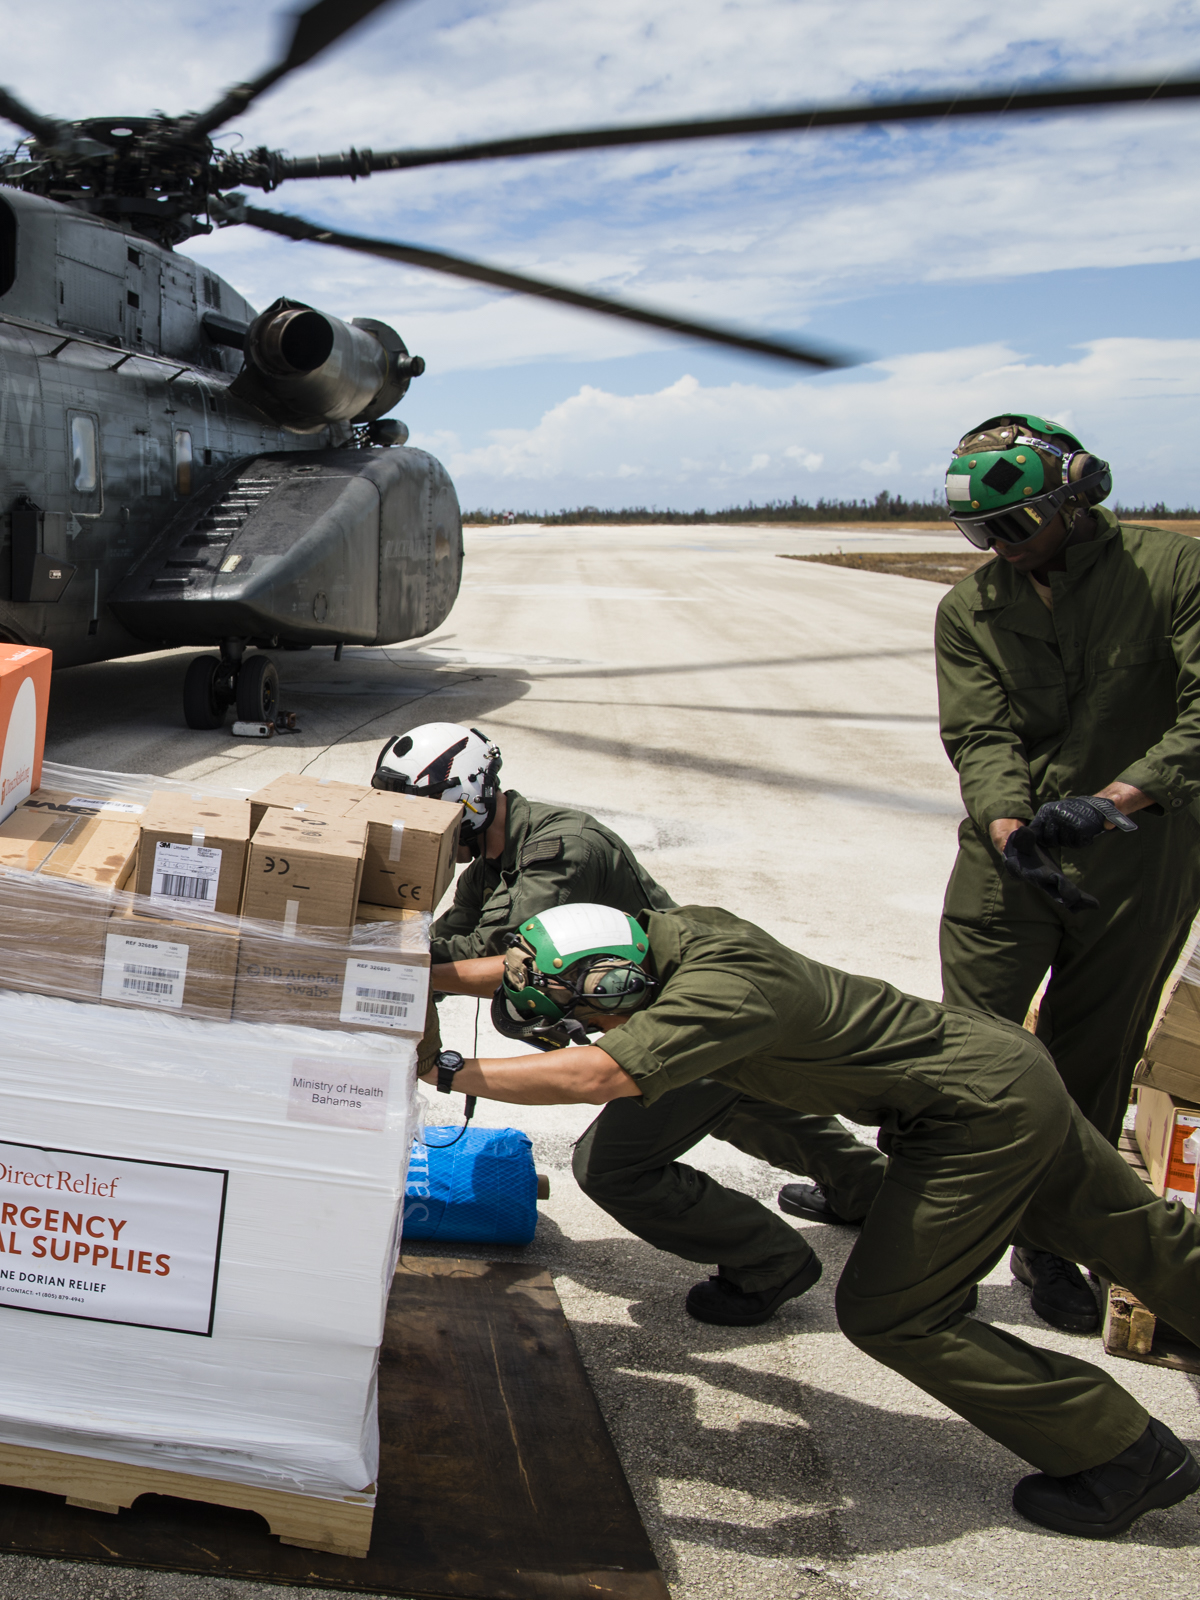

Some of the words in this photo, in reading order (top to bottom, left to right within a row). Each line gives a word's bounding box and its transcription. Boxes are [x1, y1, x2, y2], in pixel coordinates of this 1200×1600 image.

[139, 436, 162, 496] 12
[23, 800, 101, 816] 3M
[159, 841, 171, 849] 3M
[397, 883, 422, 900] CE
[263, 966, 282, 978] BD
[286, 969, 339, 985] Alcohol
[369, 964, 391, 972] 326895
[285, 983, 329, 999] Swabs
[292, 1077, 334, 1094] Ministry
[336, 1083, 347, 1093] of
[349, 1084, 384, 1098] Health
[311, 1093, 362, 1109] Bahamas
[31, 1235, 171, 1277] SUPPLIES
[19, 1272, 66, 1287] DORIAN
[68, 1278, 107, 1293] RELIEF
[6, 1286, 34, 1296] CONTACT:
[42, 1291, 57, 1300] (805)
[58, 1293, 85, 1303] 879-4943
